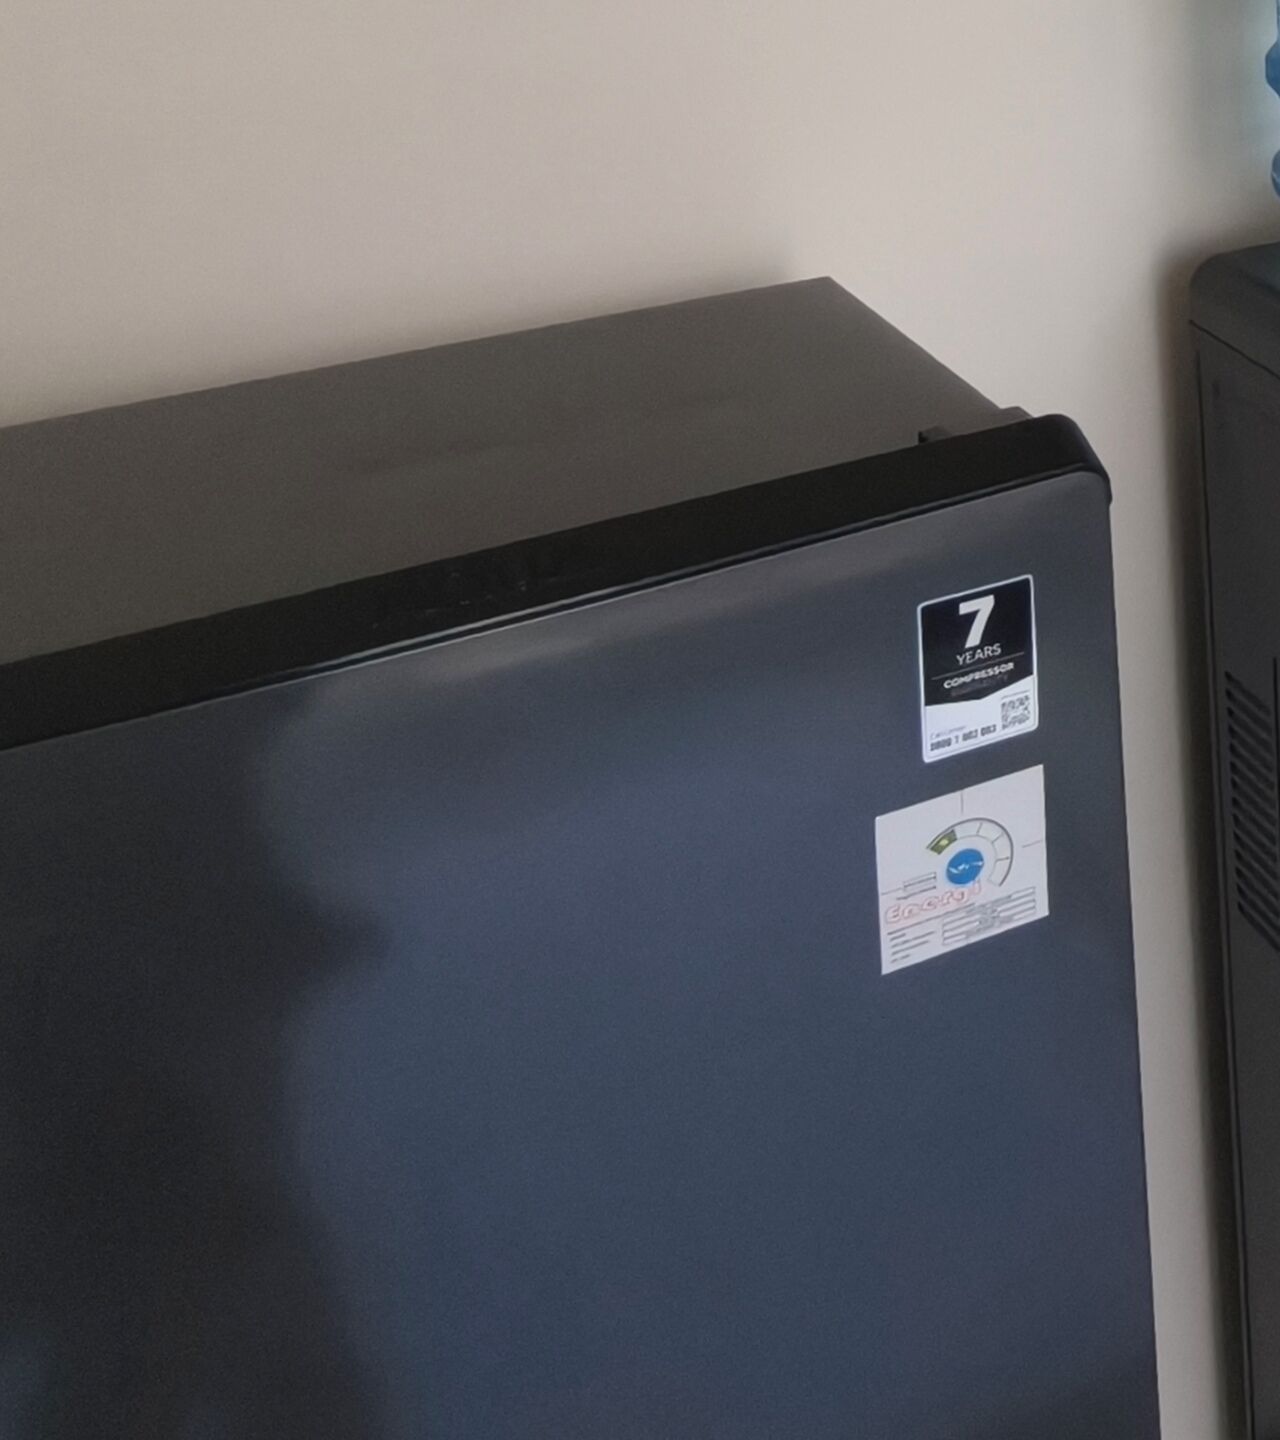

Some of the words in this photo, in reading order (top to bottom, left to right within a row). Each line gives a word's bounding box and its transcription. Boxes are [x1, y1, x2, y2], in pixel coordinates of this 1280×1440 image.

[958, 594, 995, 649] 7
[956, 643, 1001, 665] YEARS
[943, 662, 1015, 689] COMPRESSOR
